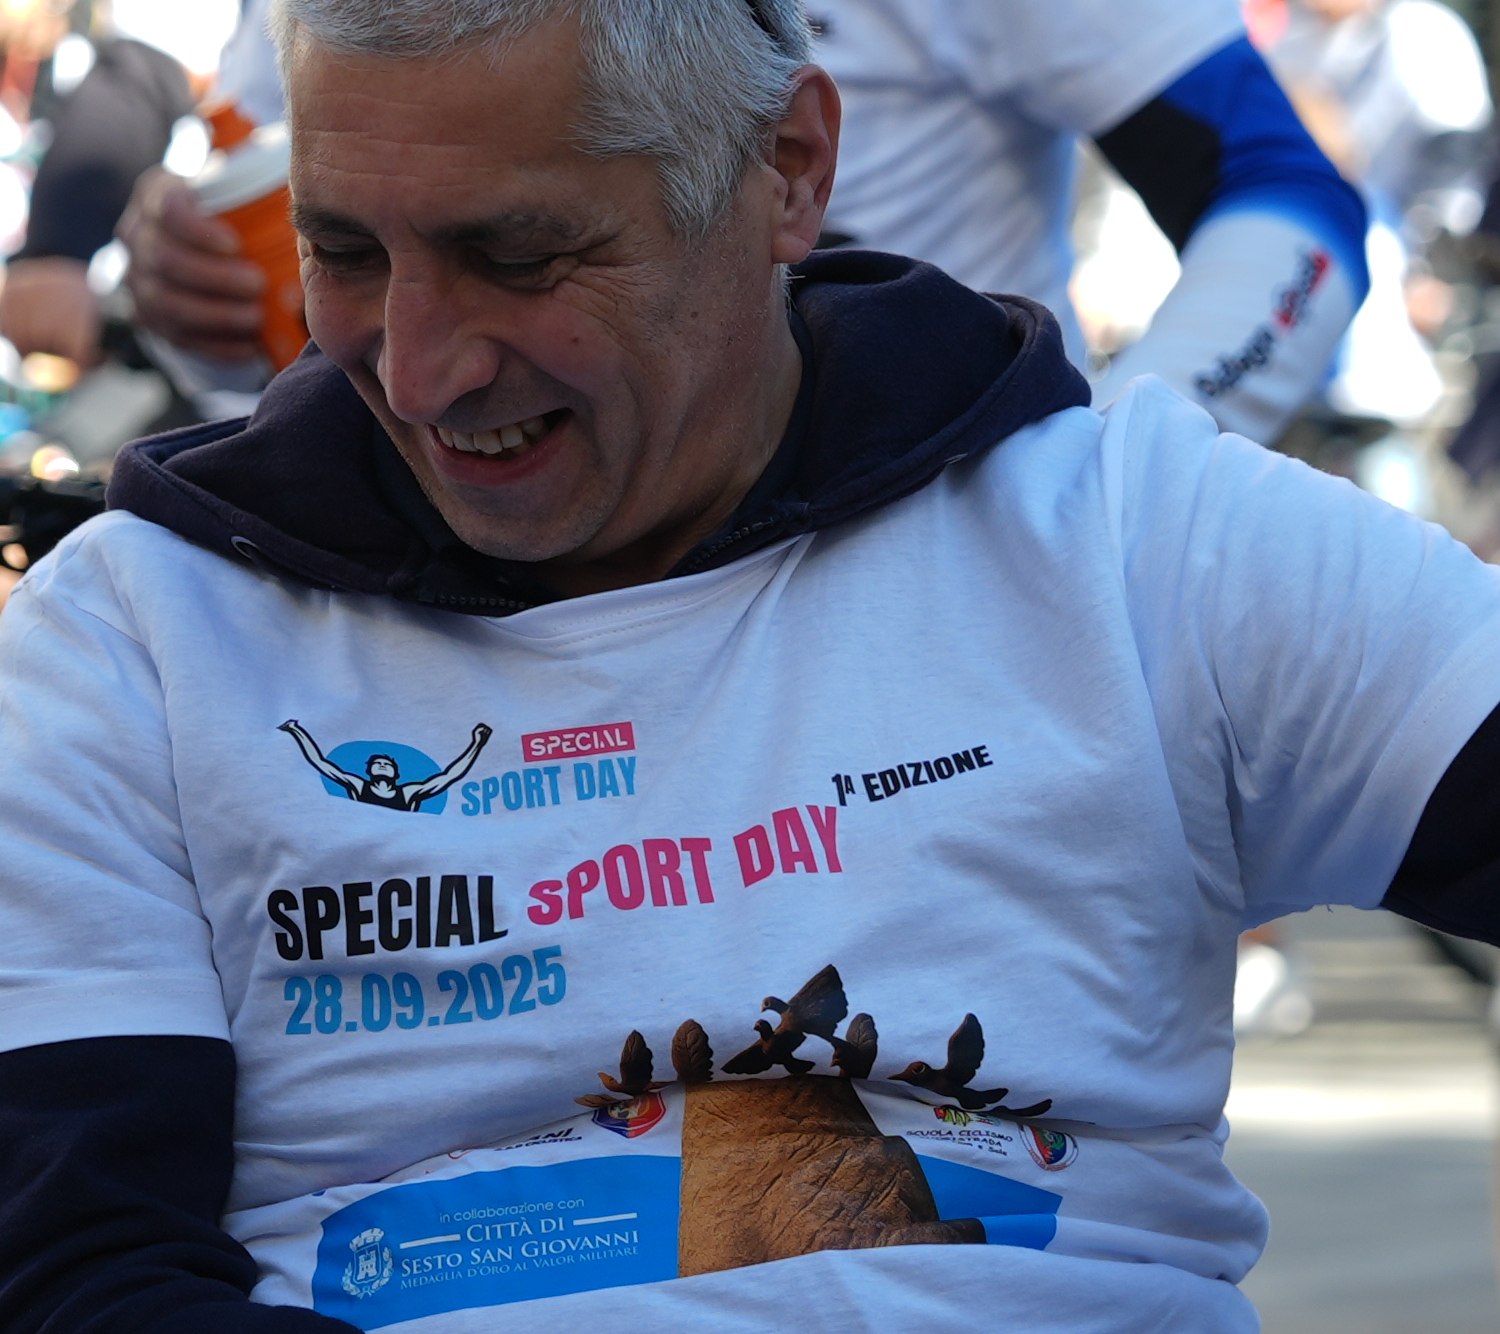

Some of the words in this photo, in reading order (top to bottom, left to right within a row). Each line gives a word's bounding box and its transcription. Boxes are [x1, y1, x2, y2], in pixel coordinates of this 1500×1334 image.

[528, 727, 629, 757] SPECIAL
[460, 766, 562, 817] SPORT
[573, 755, 637, 802] DAY
[864, 744, 994, 807] EDIZIONE
[267, 874, 510, 962] SPECIAL
[732, 803, 844, 889] DAY
[283, 945, 568, 1036] 28.09.2025
[906, 1129, 953, 1137] SCUOLA
[959, 1129, 1013, 1143] CICLISMO
[439, 1213, 451, 1224] in
[453, 1200, 555, 1223] collaborazione
[557, 1198, 585, 1211] con
[467, 1216, 530, 1243] CITTÀ
[541, 1217, 565, 1234] DI
[401, 1253, 463, 1278] SESTO
[470, 1245, 514, 1266] SAN
[521, 1230, 639, 1259] GIOVANNI
[401, 1270, 463, 1290] MEDAGLIA
[467, 1263, 510, 1279] D'ORO
[514, 1261, 529, 1272] AL
[532, 1255, 575, 1270] VALOR
[579, 1246, 639, 1263] MILITARE
